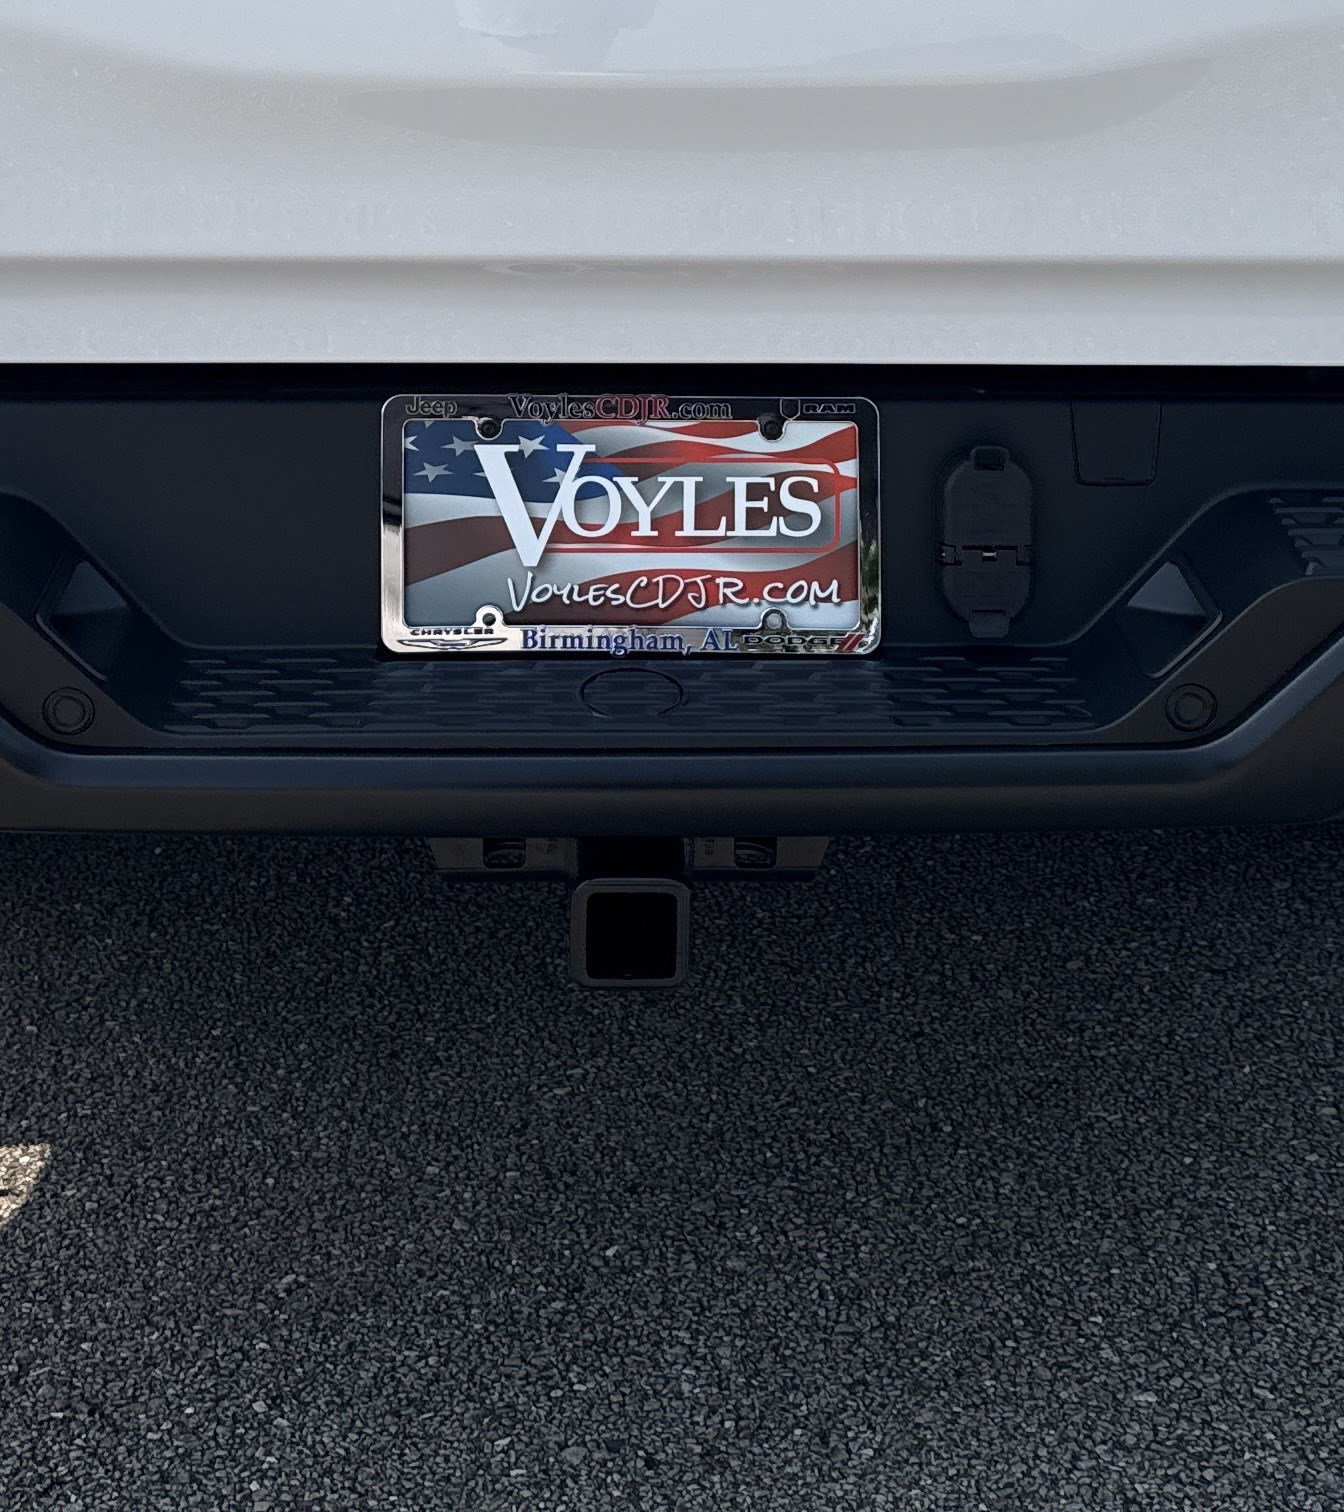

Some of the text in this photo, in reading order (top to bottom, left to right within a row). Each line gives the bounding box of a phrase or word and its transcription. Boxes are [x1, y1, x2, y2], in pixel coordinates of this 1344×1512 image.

[406, 395, 457, 418] Jeep
[508, 392, 733, 425] VoylesCDJR.com
[803, 403, 856, 414] RAM
[473, 443, 821, 568] VOYLES
[410, 627, 494, 635] CHRYSLER
[520, 625, 739, 656] Birmingham, AL
[743, 635, 844, 645] DODGE
